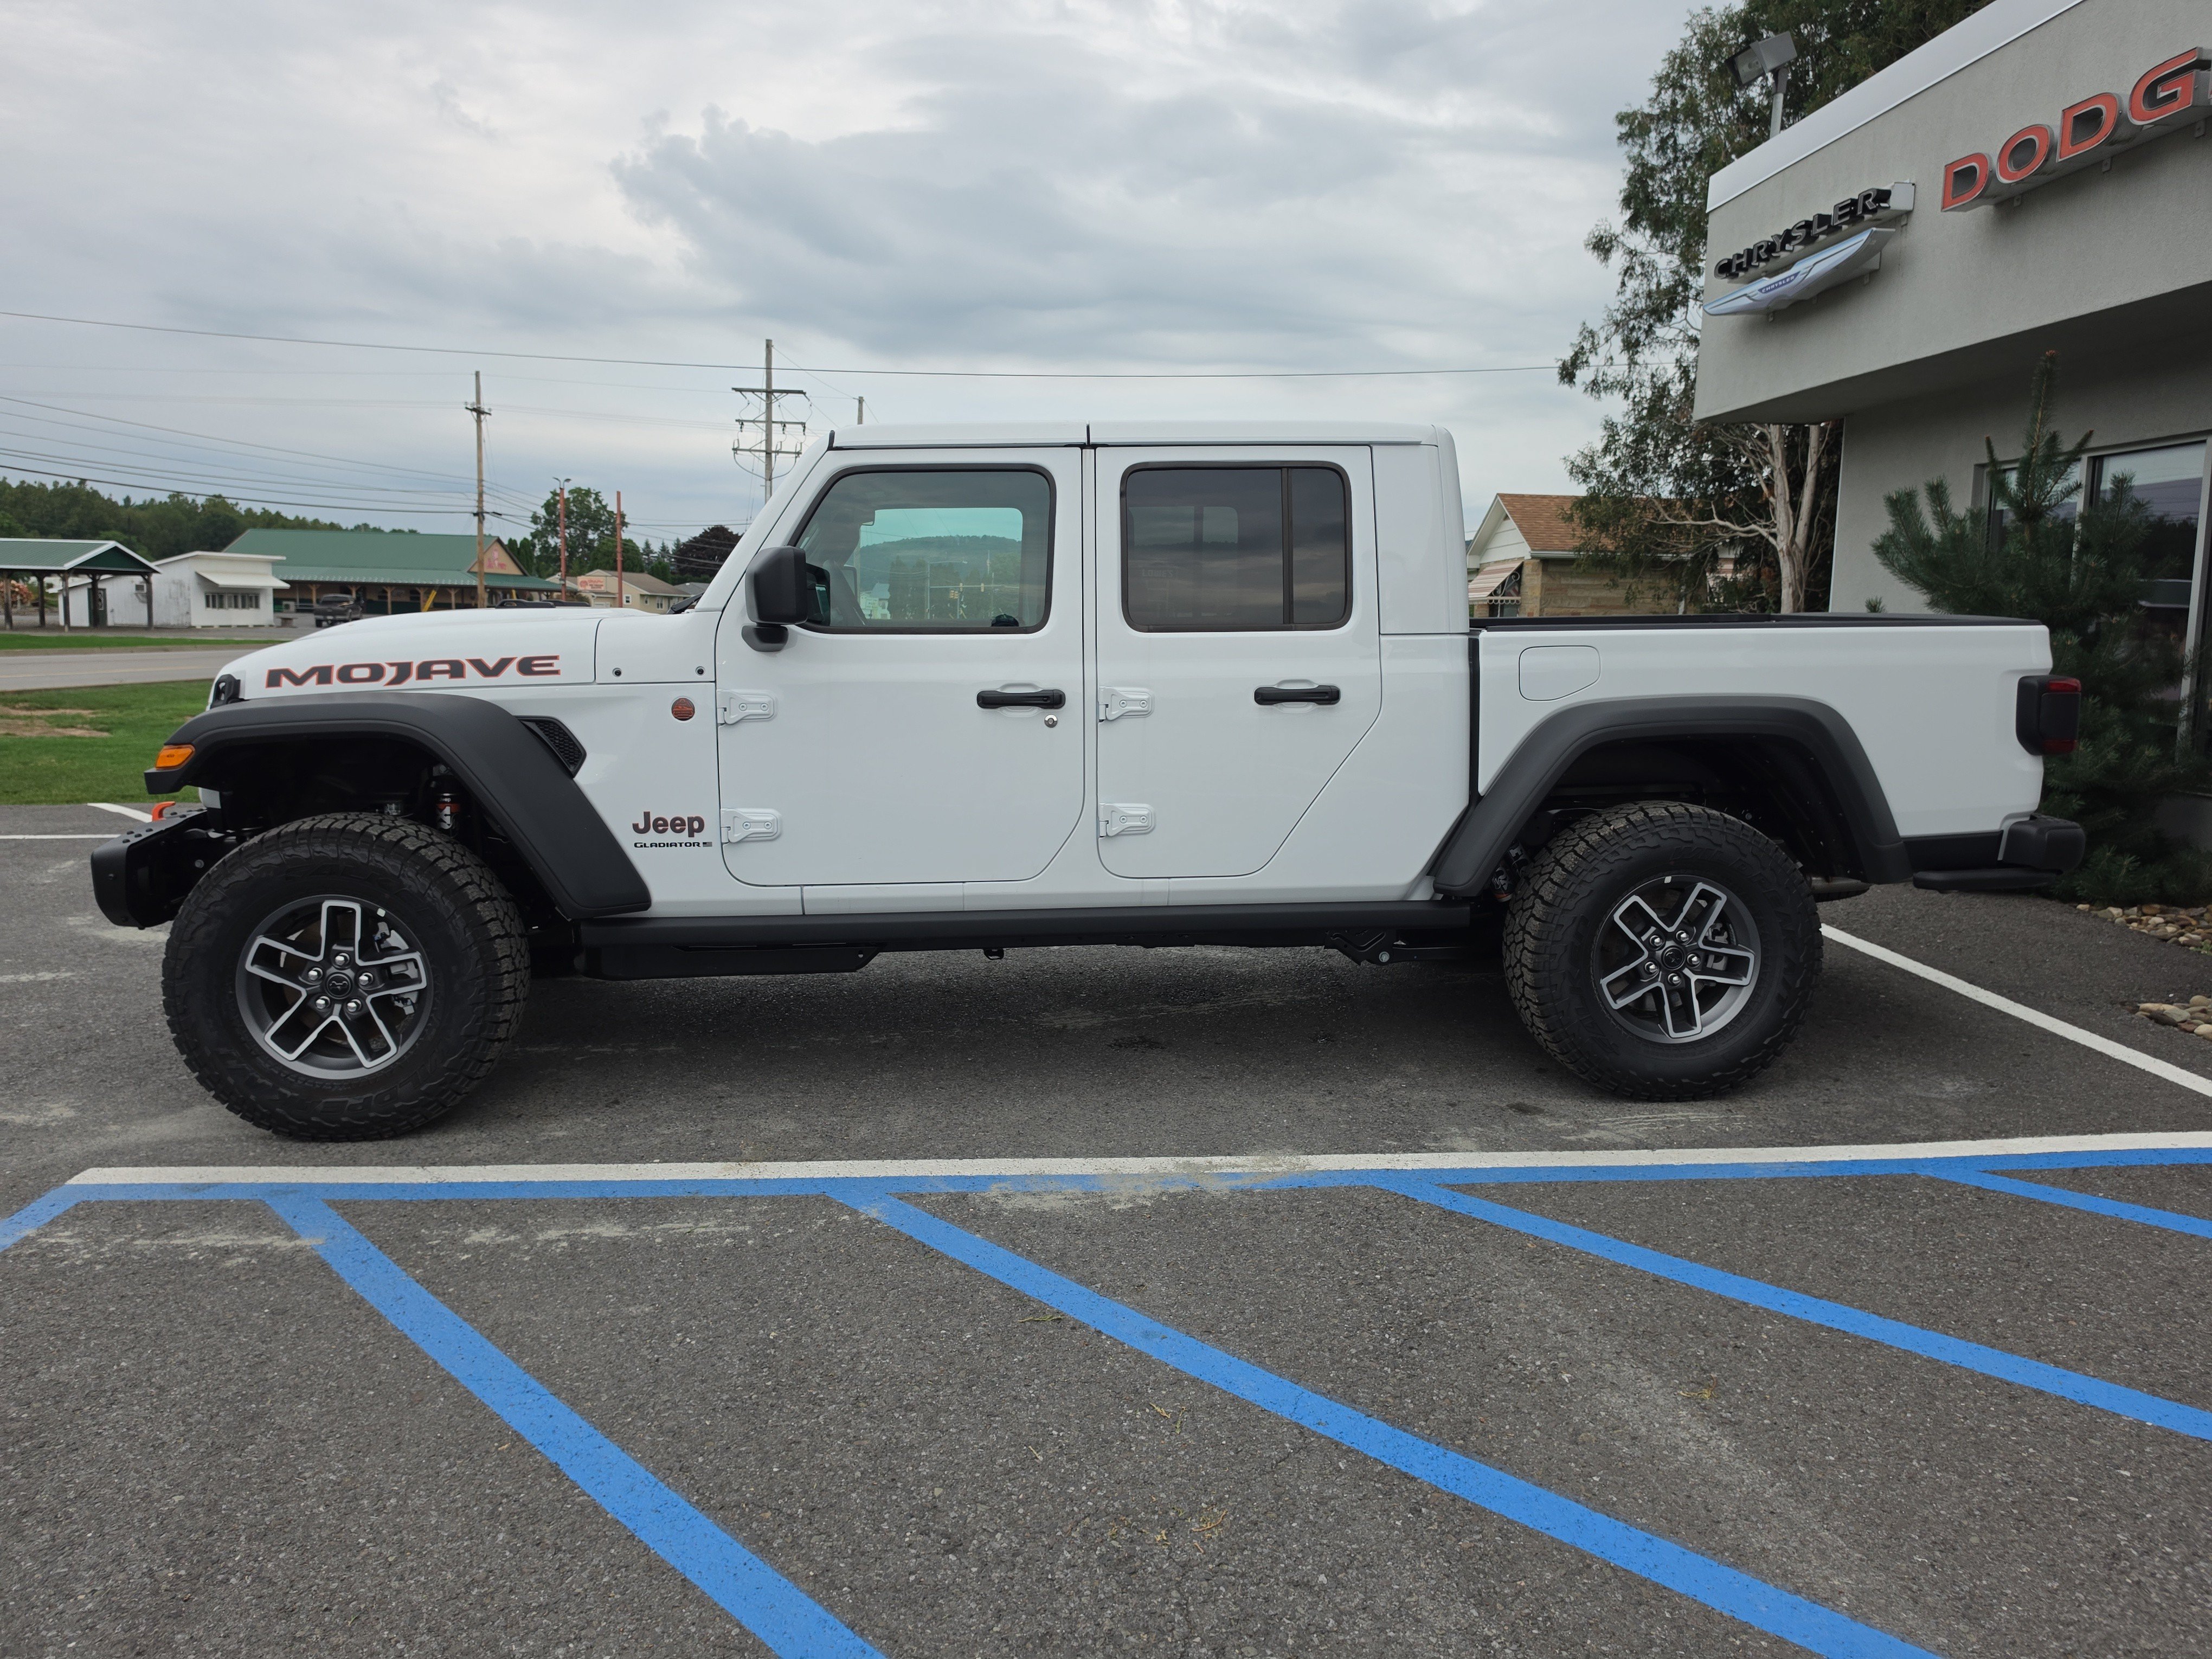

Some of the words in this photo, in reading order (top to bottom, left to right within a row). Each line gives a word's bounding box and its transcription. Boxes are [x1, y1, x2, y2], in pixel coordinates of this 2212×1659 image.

[1941, 47, 2212, 213] DODG
[1714, 188, 1883, 279] CHRYSLER
[1761, 274, 1795, 293] CHRYSLER
[265, 655, 561, 689] MOJAVE
[632, 811, 705, 838] Jeep
